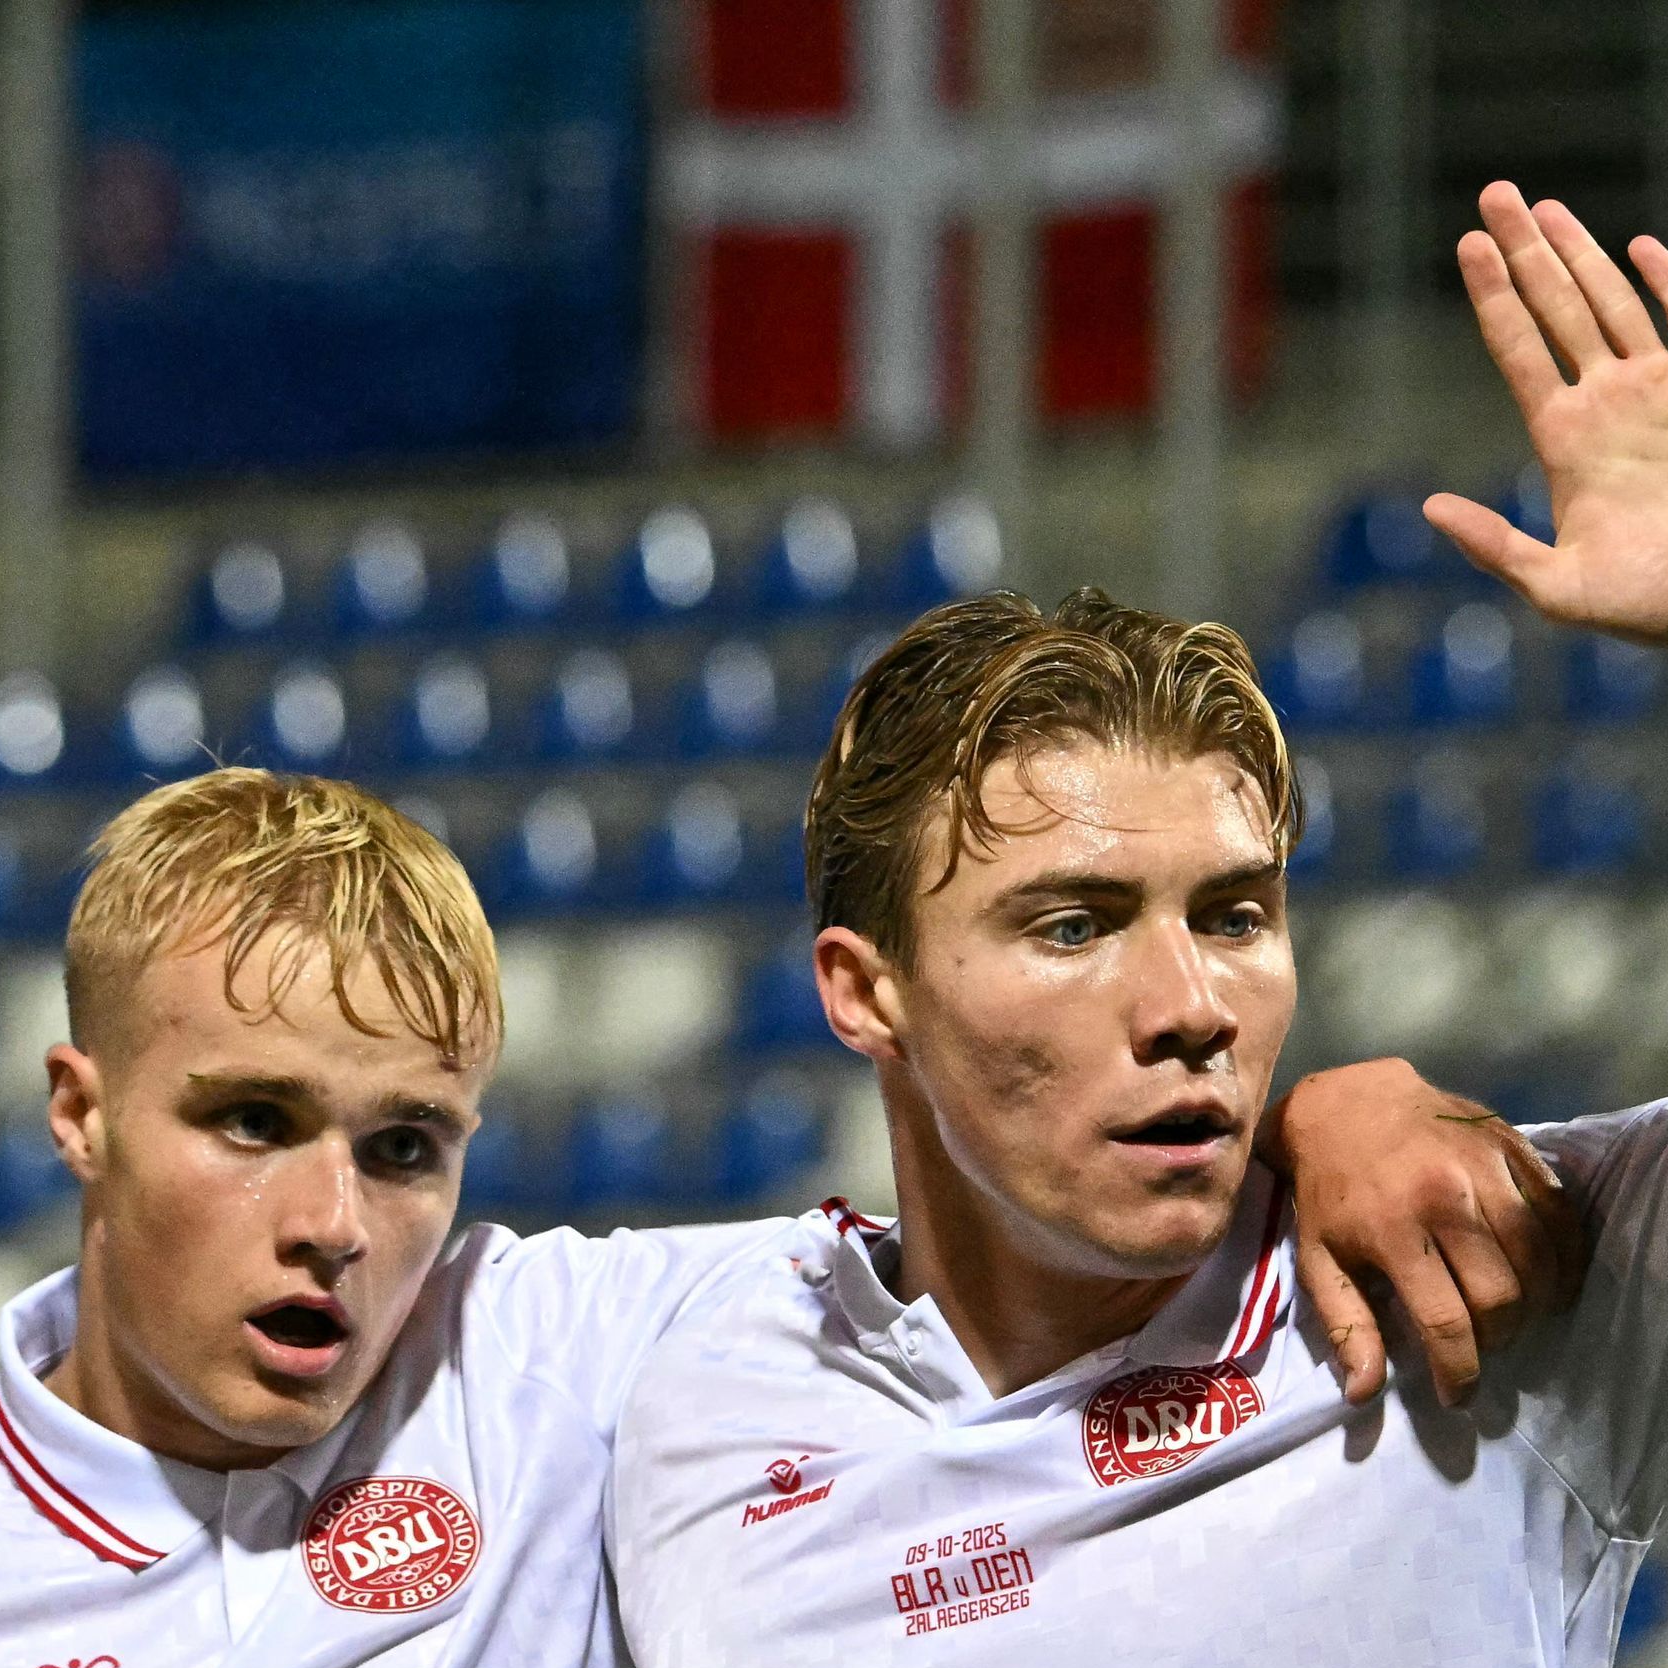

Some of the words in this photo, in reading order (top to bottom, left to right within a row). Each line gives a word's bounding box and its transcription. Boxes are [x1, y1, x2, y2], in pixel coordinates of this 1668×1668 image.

[1123, 1400, 1226, 1454] DBU
[742, 1478, 835, 1527] hummel
[335, 1510, 446, 1581] DBU
[905, 1522, 1007, 1565] 09-10-2025
[309, 1538, 374, 1606] DANSK
[387, 1573, 453, 1608] 1889
[891, 1566, 949, 1613] BLR
[971, 1547, 1034, 1595] DEN
[906, 1589, 1030, 1636] ZALAEGERSZEG
